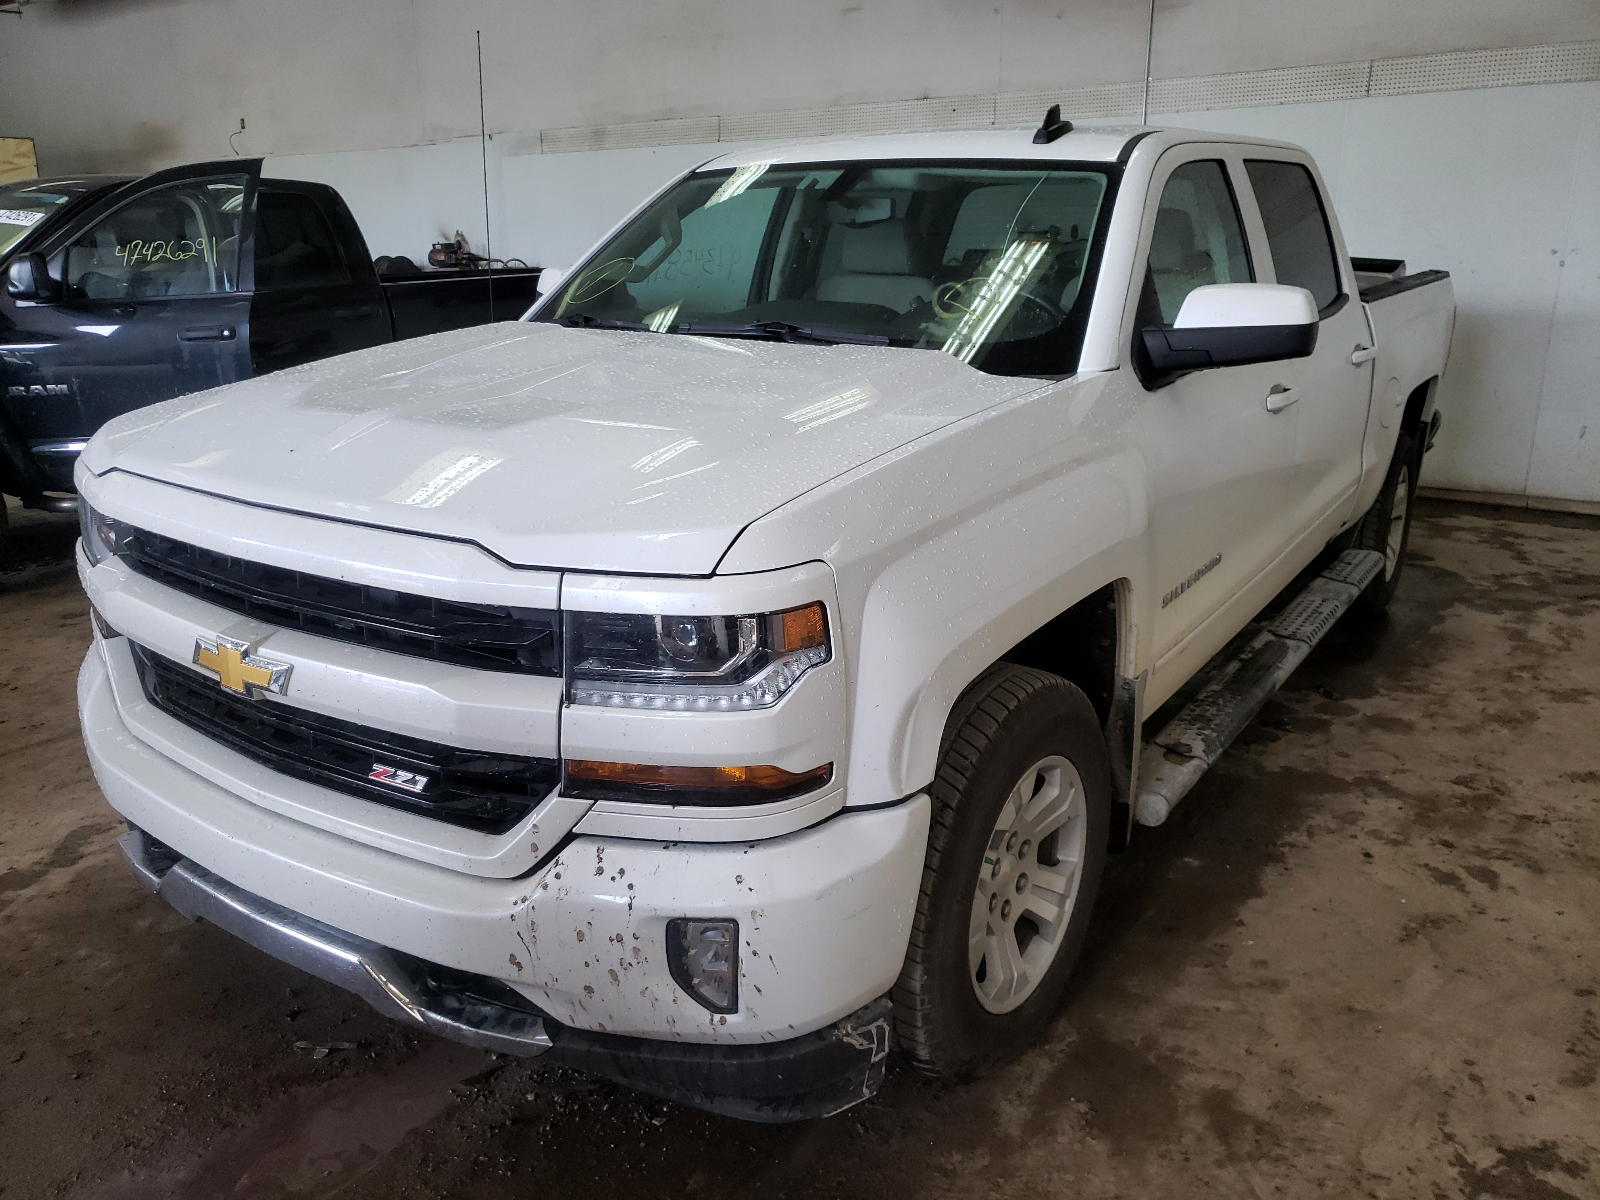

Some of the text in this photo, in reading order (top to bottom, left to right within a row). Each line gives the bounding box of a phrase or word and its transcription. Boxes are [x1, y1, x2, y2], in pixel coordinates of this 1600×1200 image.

[115, 236, 218, 267] 47426291
[7, 384, 70, 396] RAM
[368, 763, 429, 793] Z71
